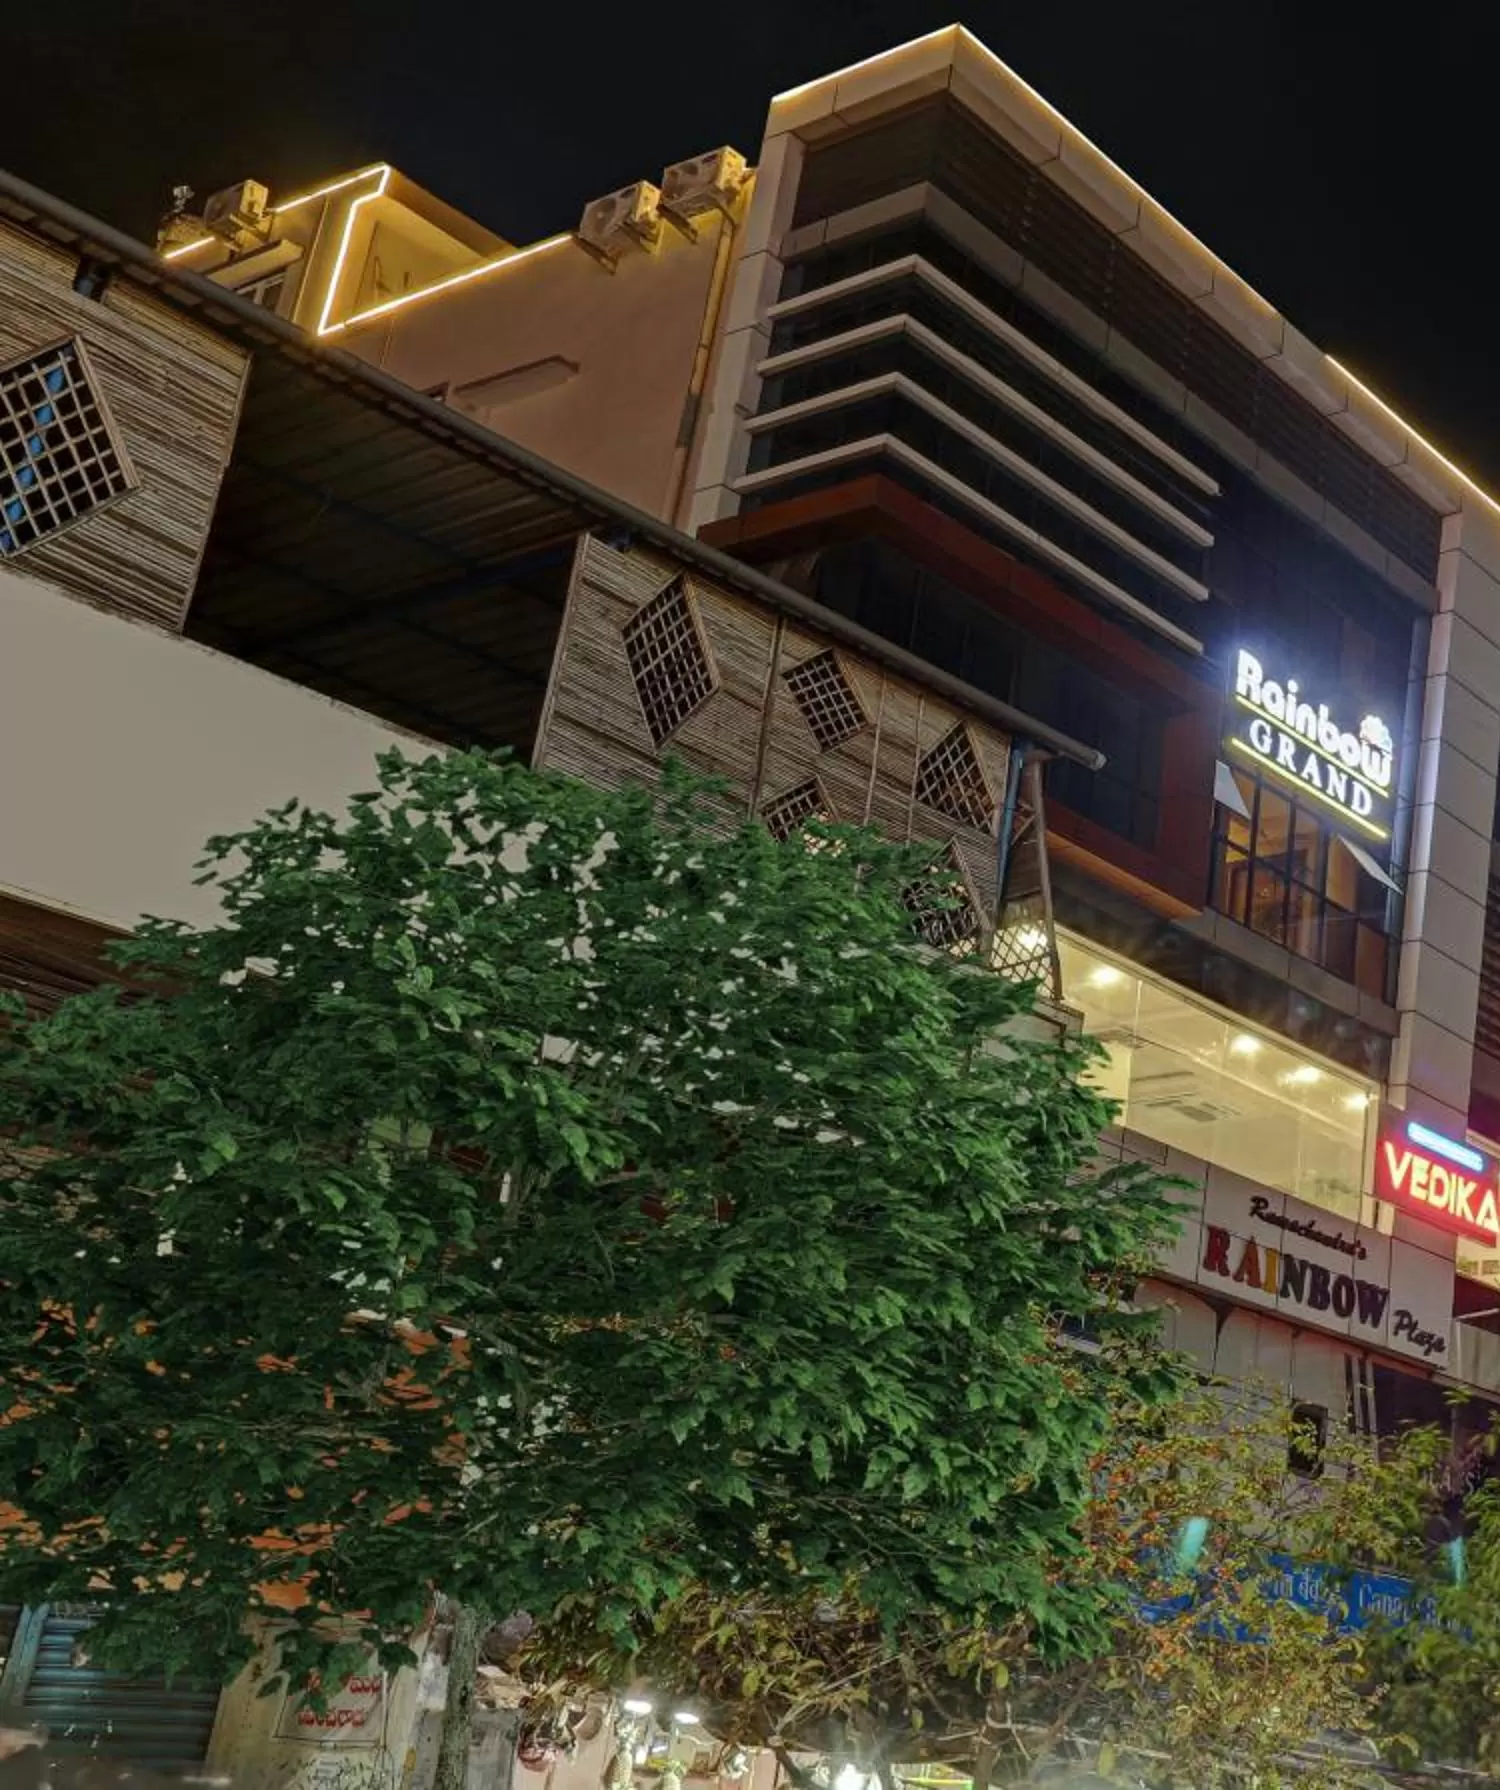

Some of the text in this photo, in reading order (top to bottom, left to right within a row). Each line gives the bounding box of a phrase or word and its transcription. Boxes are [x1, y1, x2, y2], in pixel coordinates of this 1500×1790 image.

[1235, 648, 1393, 788] Rainbow
[1249, 718, 1374, 817] GRAND
[1384, 1140, 1500, 1234] VEDIKA
[1202, 1225, 1446, 1357] RAINBOW Plaza
